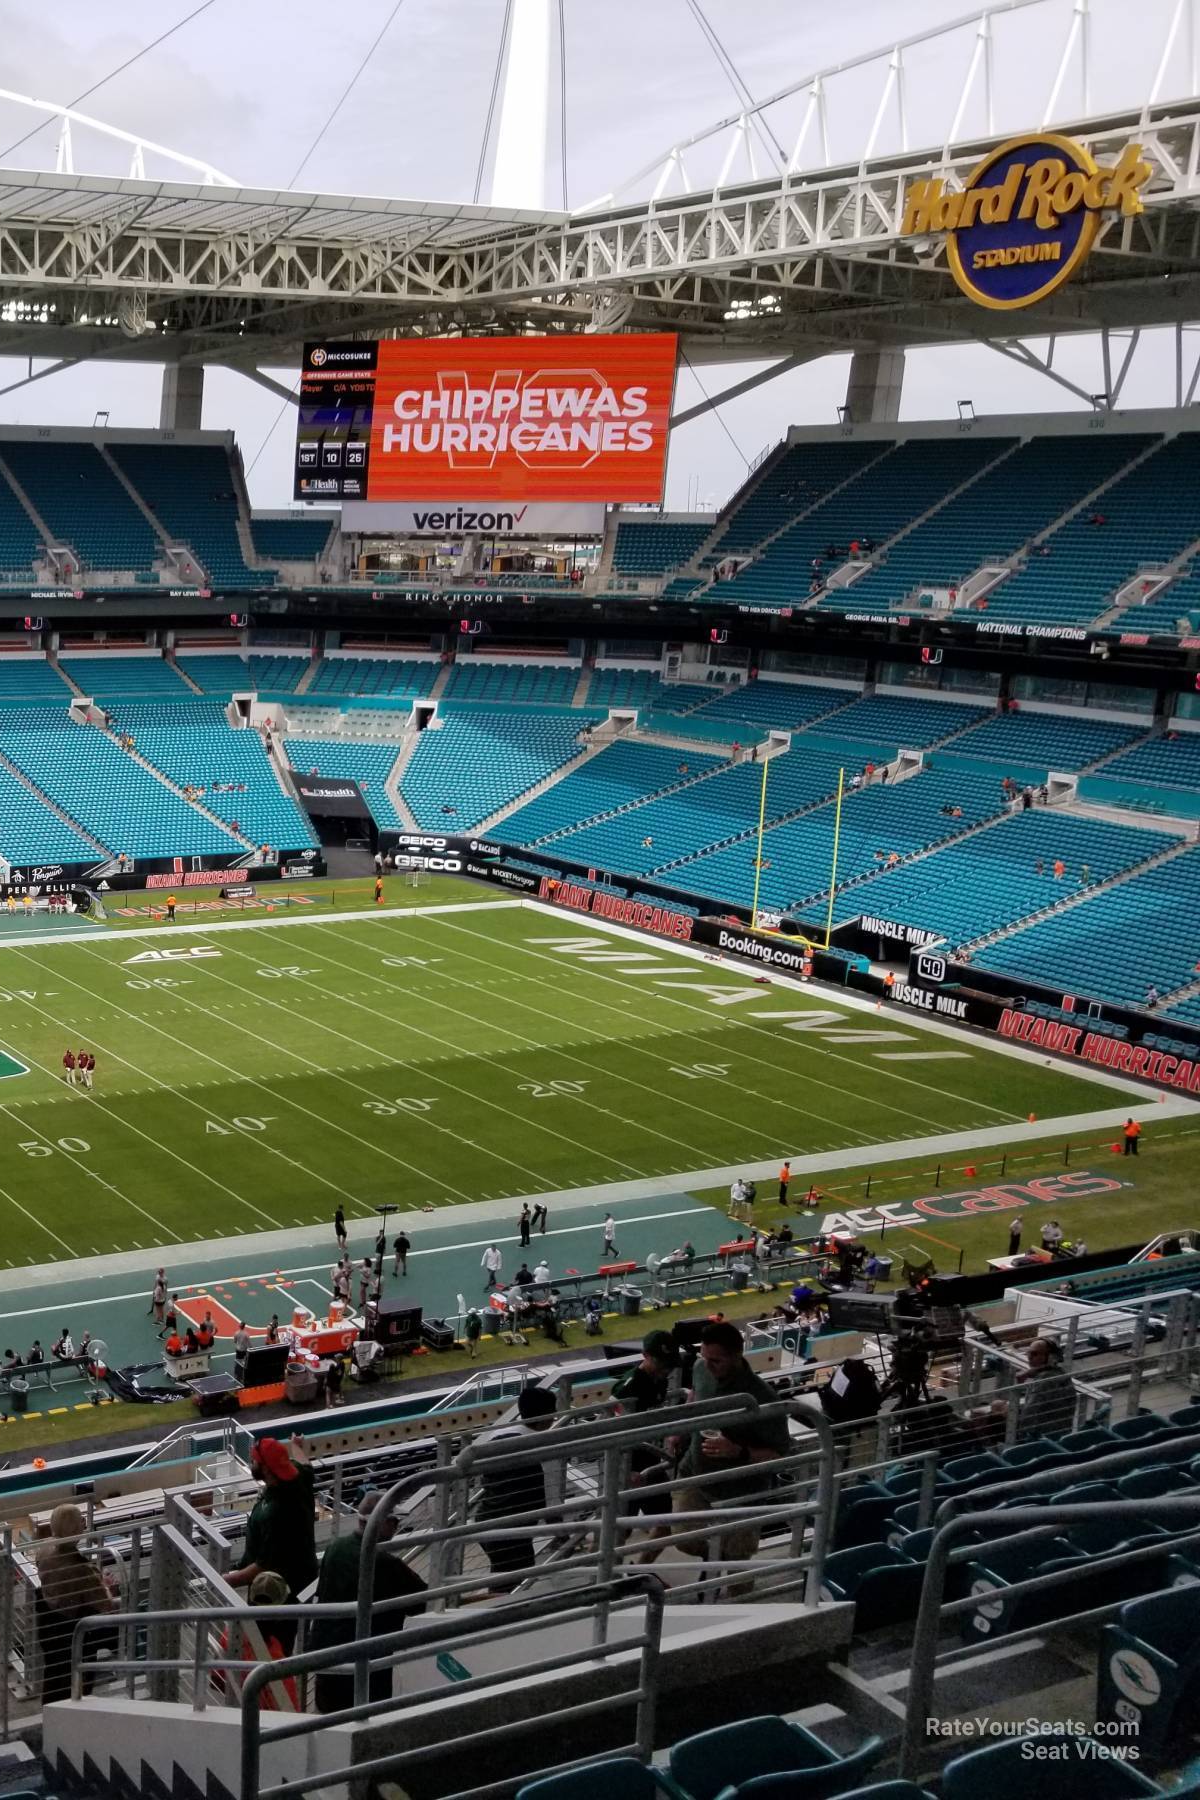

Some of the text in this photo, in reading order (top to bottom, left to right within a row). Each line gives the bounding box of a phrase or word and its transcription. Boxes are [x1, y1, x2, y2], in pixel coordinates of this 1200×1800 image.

[900, 143, 1152, 235] Hard Rock
[972, 241, 1062, 269] STADIUM
[393, 386, 649, 420] CHIPPEWAS
[382, 420, 655, 453] HURRICANES
[301, 454, 315, 462] 1ST
[326, 453, 337, 462] 10
[413, 507, 514, 531] verizon
[405, 592, 440, 601] RING
[452, 593, 503, 603] HONOR
[738, 605, 750, 613] TED
[845, 614, 870, 622] GEORGE
[976, 622, 1087, 640] NATIONAL CHAMPIONS
[399, 835, 447, 847] GEICO
[394, 854, 462, 872] GEICO
[146, 868, 248, 889] MIAMI HURRICANES
[592, 890, 694, 941] HURRICANES
[861, 915, 937, 946] MUSCLE MILK
[120, 946, 224, 965] ACC
[718, 930, 805, 970] Booking.com
[255, 965, 311, 979] 20
[381, 956, 429, 969] 10
[922, 959, 942, 977] 40
[124, 977, 181, 991] 30
[522, 937, 974, 1060] MIAMI
[936, 995, 968, 1019] MILK
[997, 1008, 1083, 1055] MIAMI
[668, 1062, 729, 1080] 10
[517, 1078, 586, 1099] 20
[362, 1096, 435, 1116] 30
[205, 1115, 268, 1137] 40
[16, 1136, 92, 1158] 50
[818, 1202, 928, 1235] ACC
